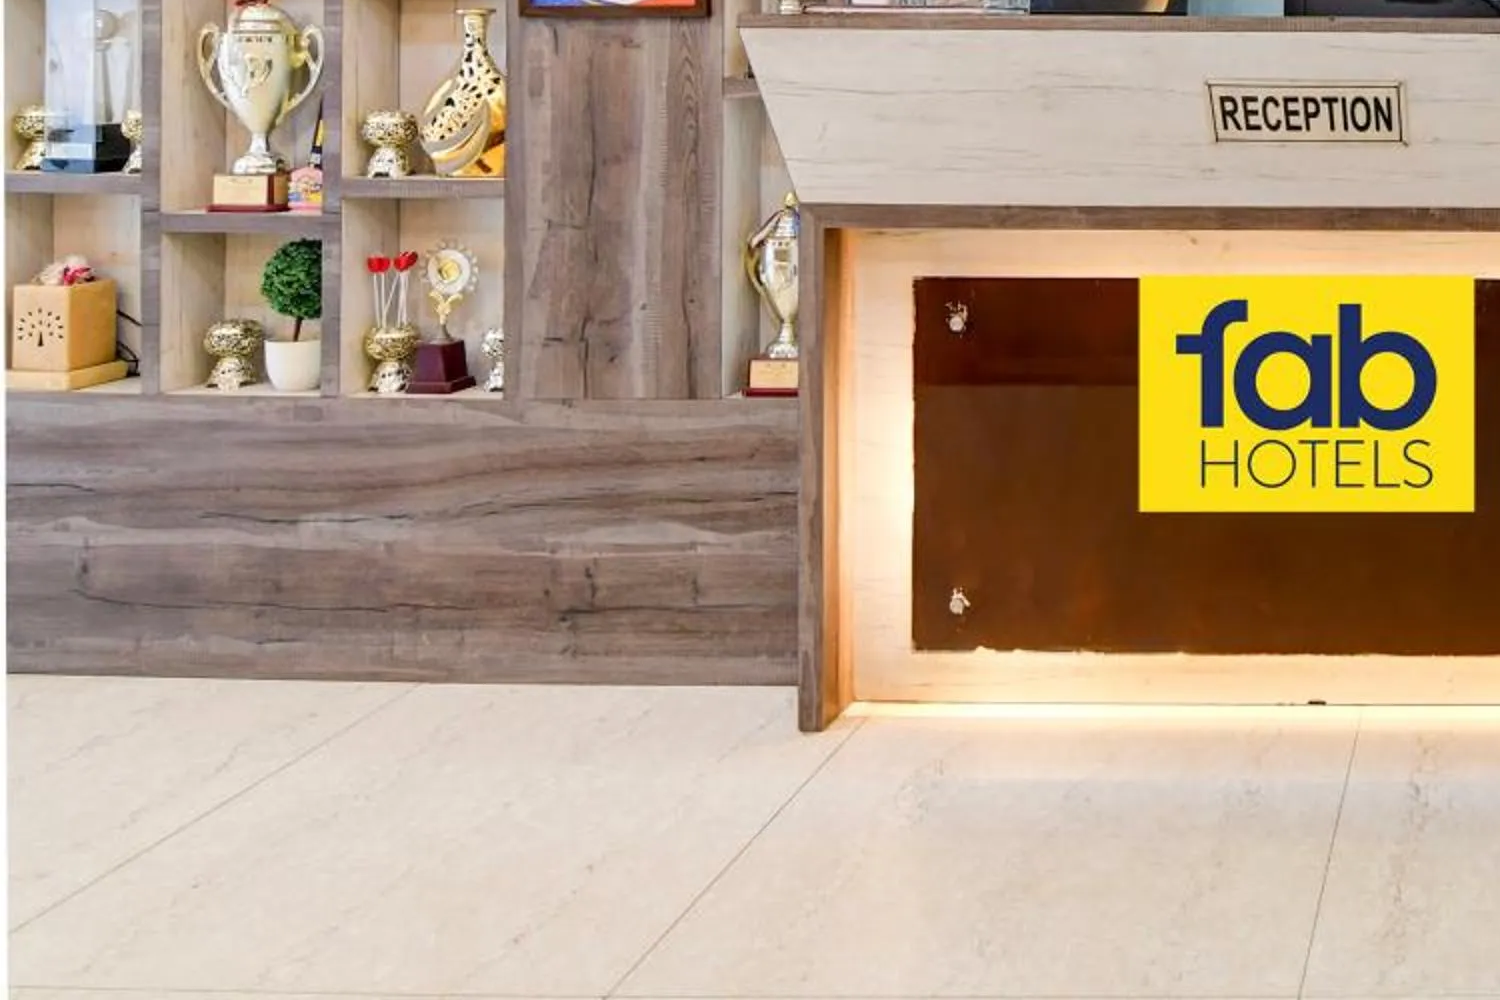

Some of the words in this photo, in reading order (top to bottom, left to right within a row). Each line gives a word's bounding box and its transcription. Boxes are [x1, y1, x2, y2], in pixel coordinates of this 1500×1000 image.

[1218, 95, 1393, 133] RECEPTION
[1176, 299, 1437, 431] fab
[1201, 439, 1433, 488] HOTELS
